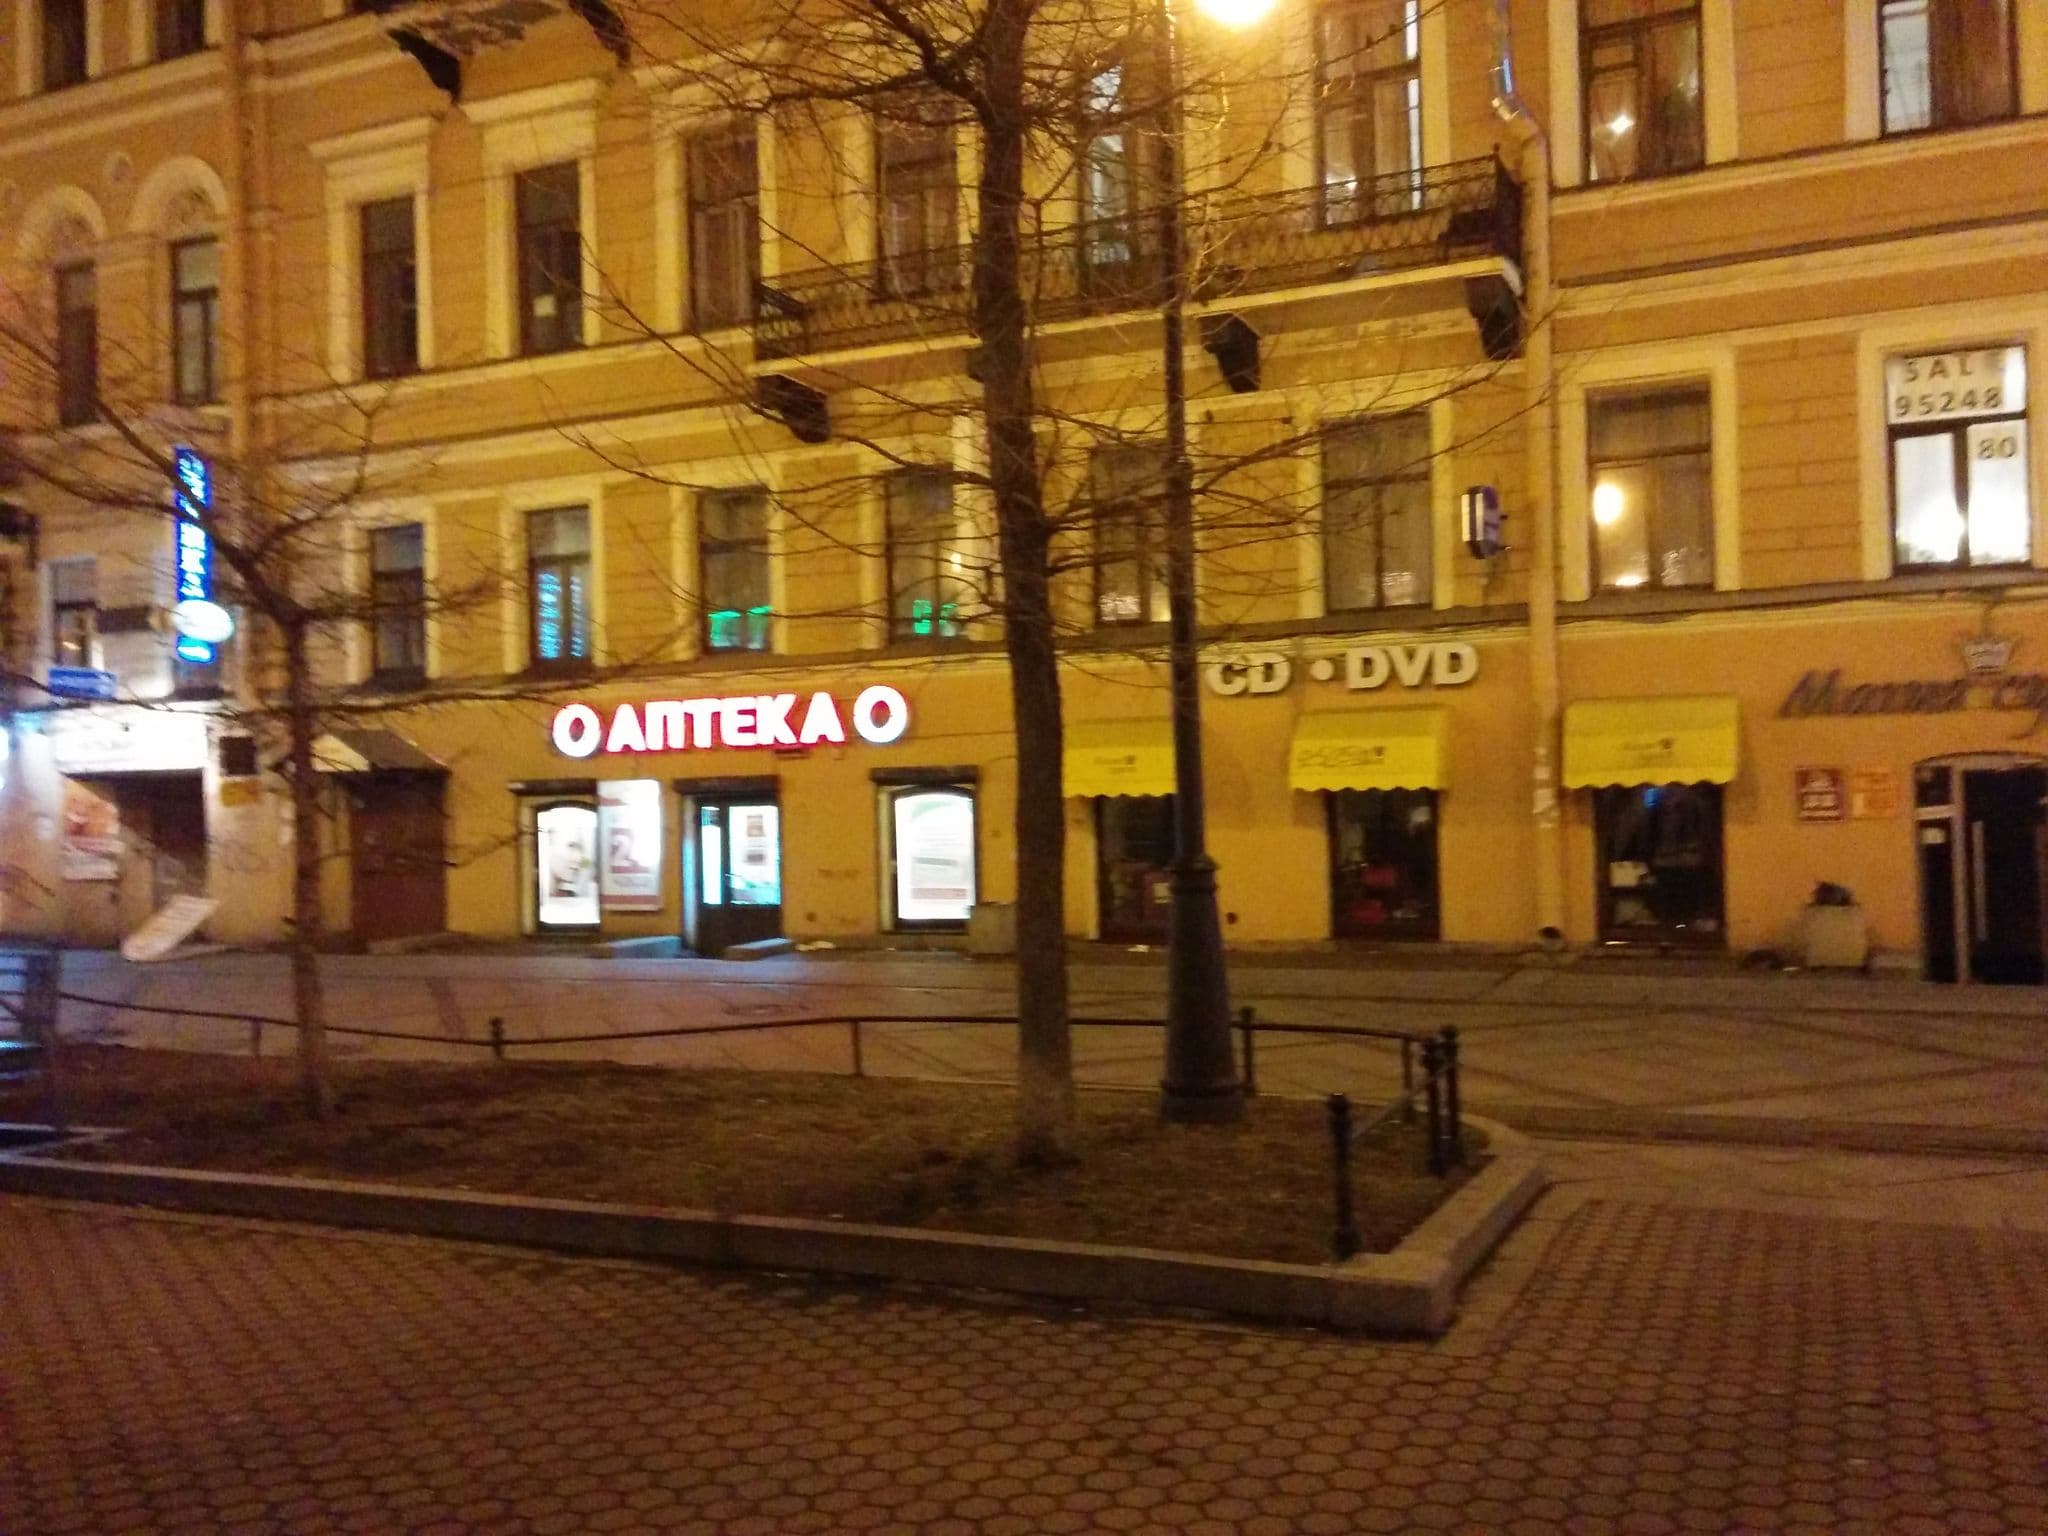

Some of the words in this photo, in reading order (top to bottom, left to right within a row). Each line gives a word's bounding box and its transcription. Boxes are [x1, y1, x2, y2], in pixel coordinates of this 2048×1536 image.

[1895, 386, 2002, 417] 95248
[1978, 436, 2018, 459] 80
[1206, 651, 1292, 696] CD
[1344, 642, 1480, 690] DVD
[604, 692, 847, 754] АПТЕКА
